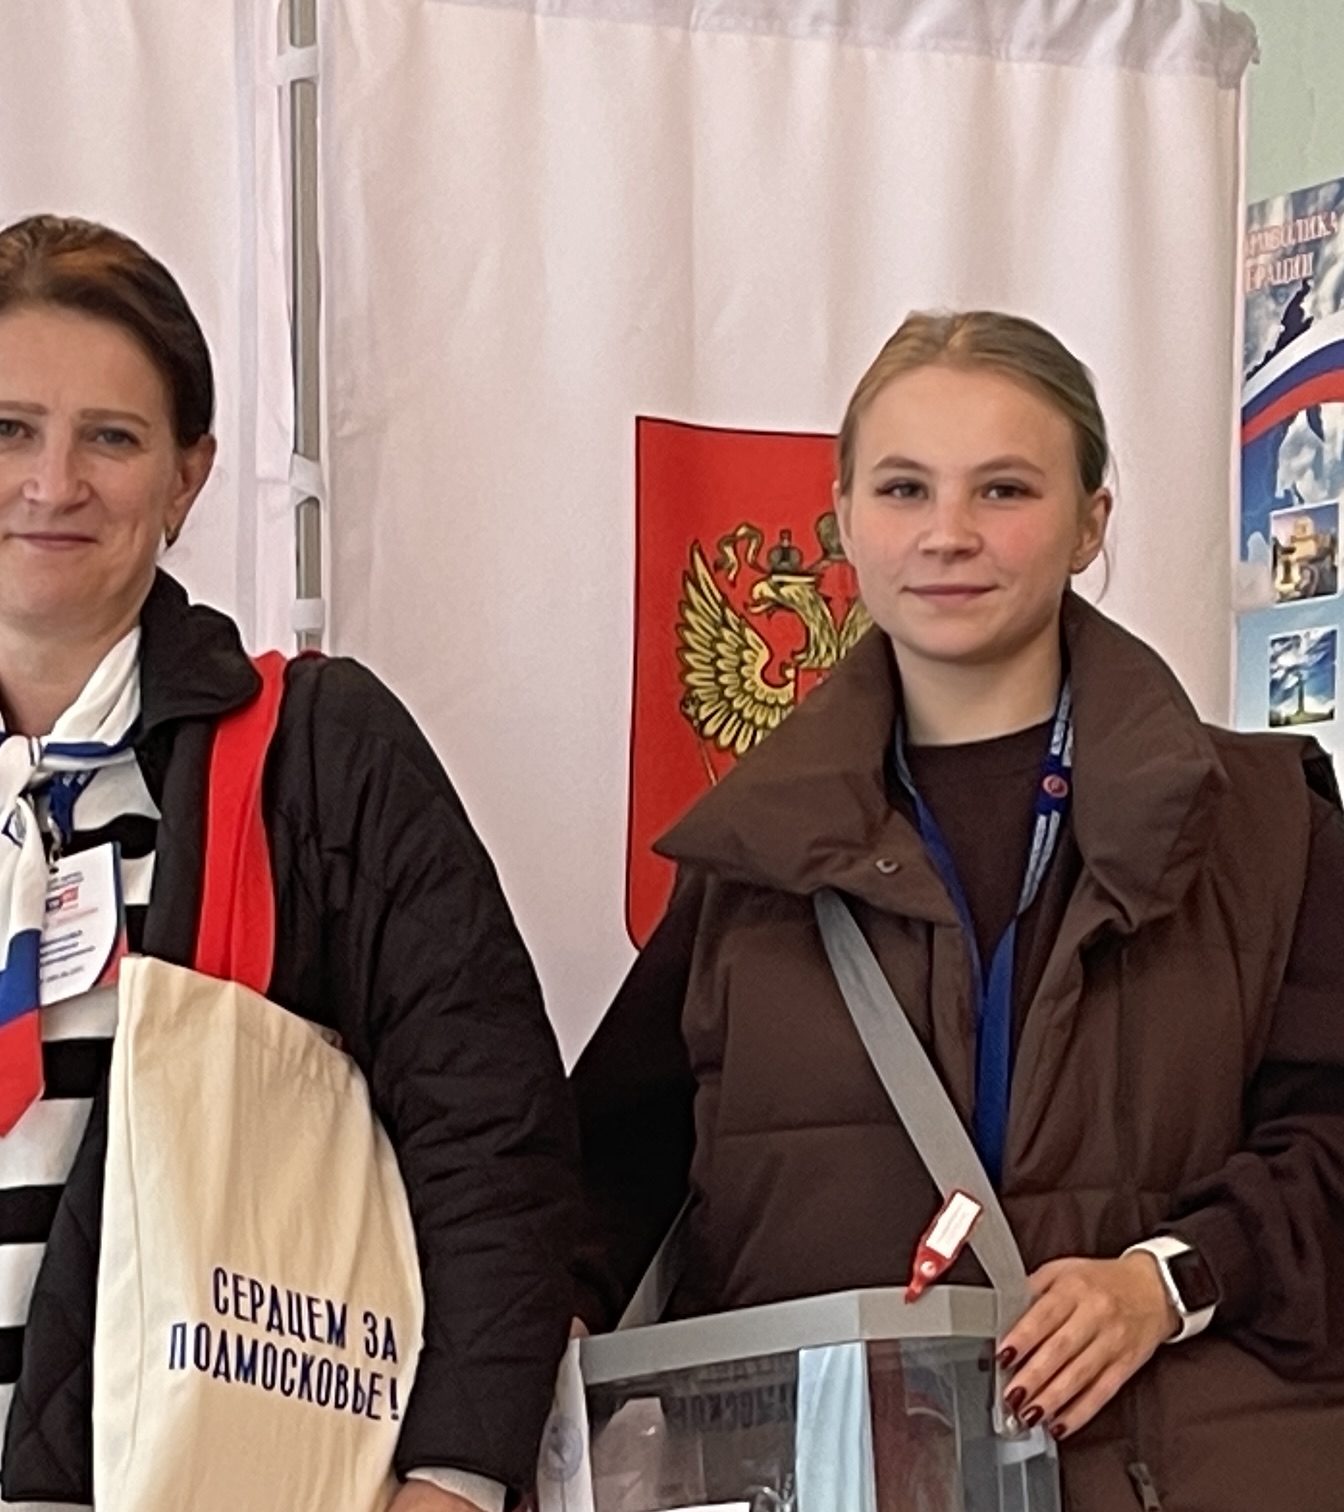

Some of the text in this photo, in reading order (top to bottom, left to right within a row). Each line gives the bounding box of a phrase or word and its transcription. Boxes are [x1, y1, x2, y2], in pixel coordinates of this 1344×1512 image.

[212, 1266, 399, 1364] СЕРДЦЕМ ЗА
[168, 1322, 400, 1421] ПОДМОСКОВЬЕ!
